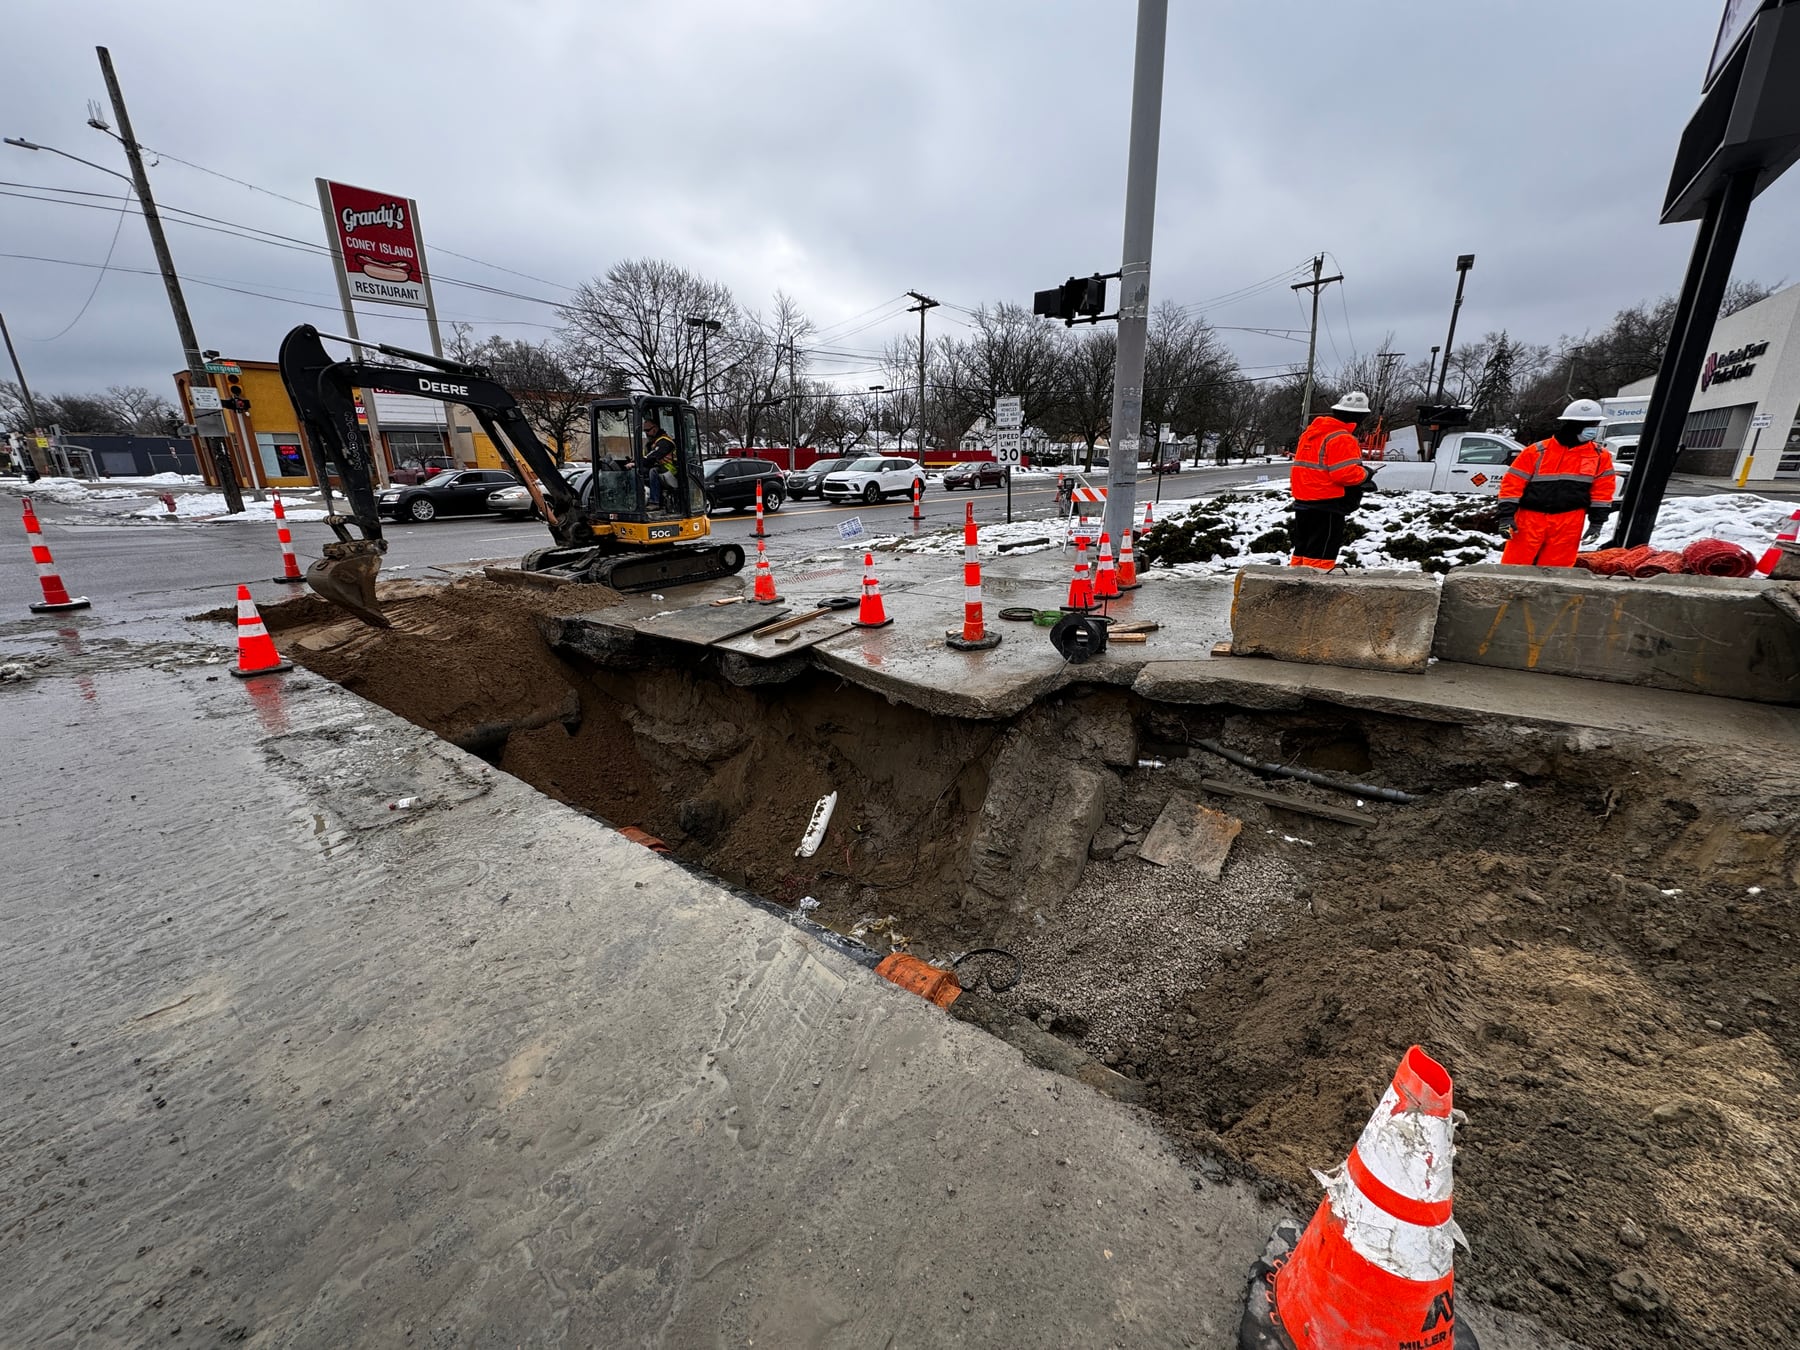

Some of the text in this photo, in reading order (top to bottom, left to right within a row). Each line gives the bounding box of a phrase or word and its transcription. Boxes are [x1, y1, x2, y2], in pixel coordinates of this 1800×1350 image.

[342, 203, 405, 233] Grandy's
[345, 236, 414, 259] CONEY ISLAND
[355, 281, 419, 300] RESTAURANT
[206, 364, 241, 374] Evergreen
[418, 378, 469, 396] DEERE
[1617, 407, 1648, 417] Shred-i
[999, 448, 1019, 462] 30
[651, 530, 671, 539] 50G
[1399, 1331, 1447, 1350] MILLER
